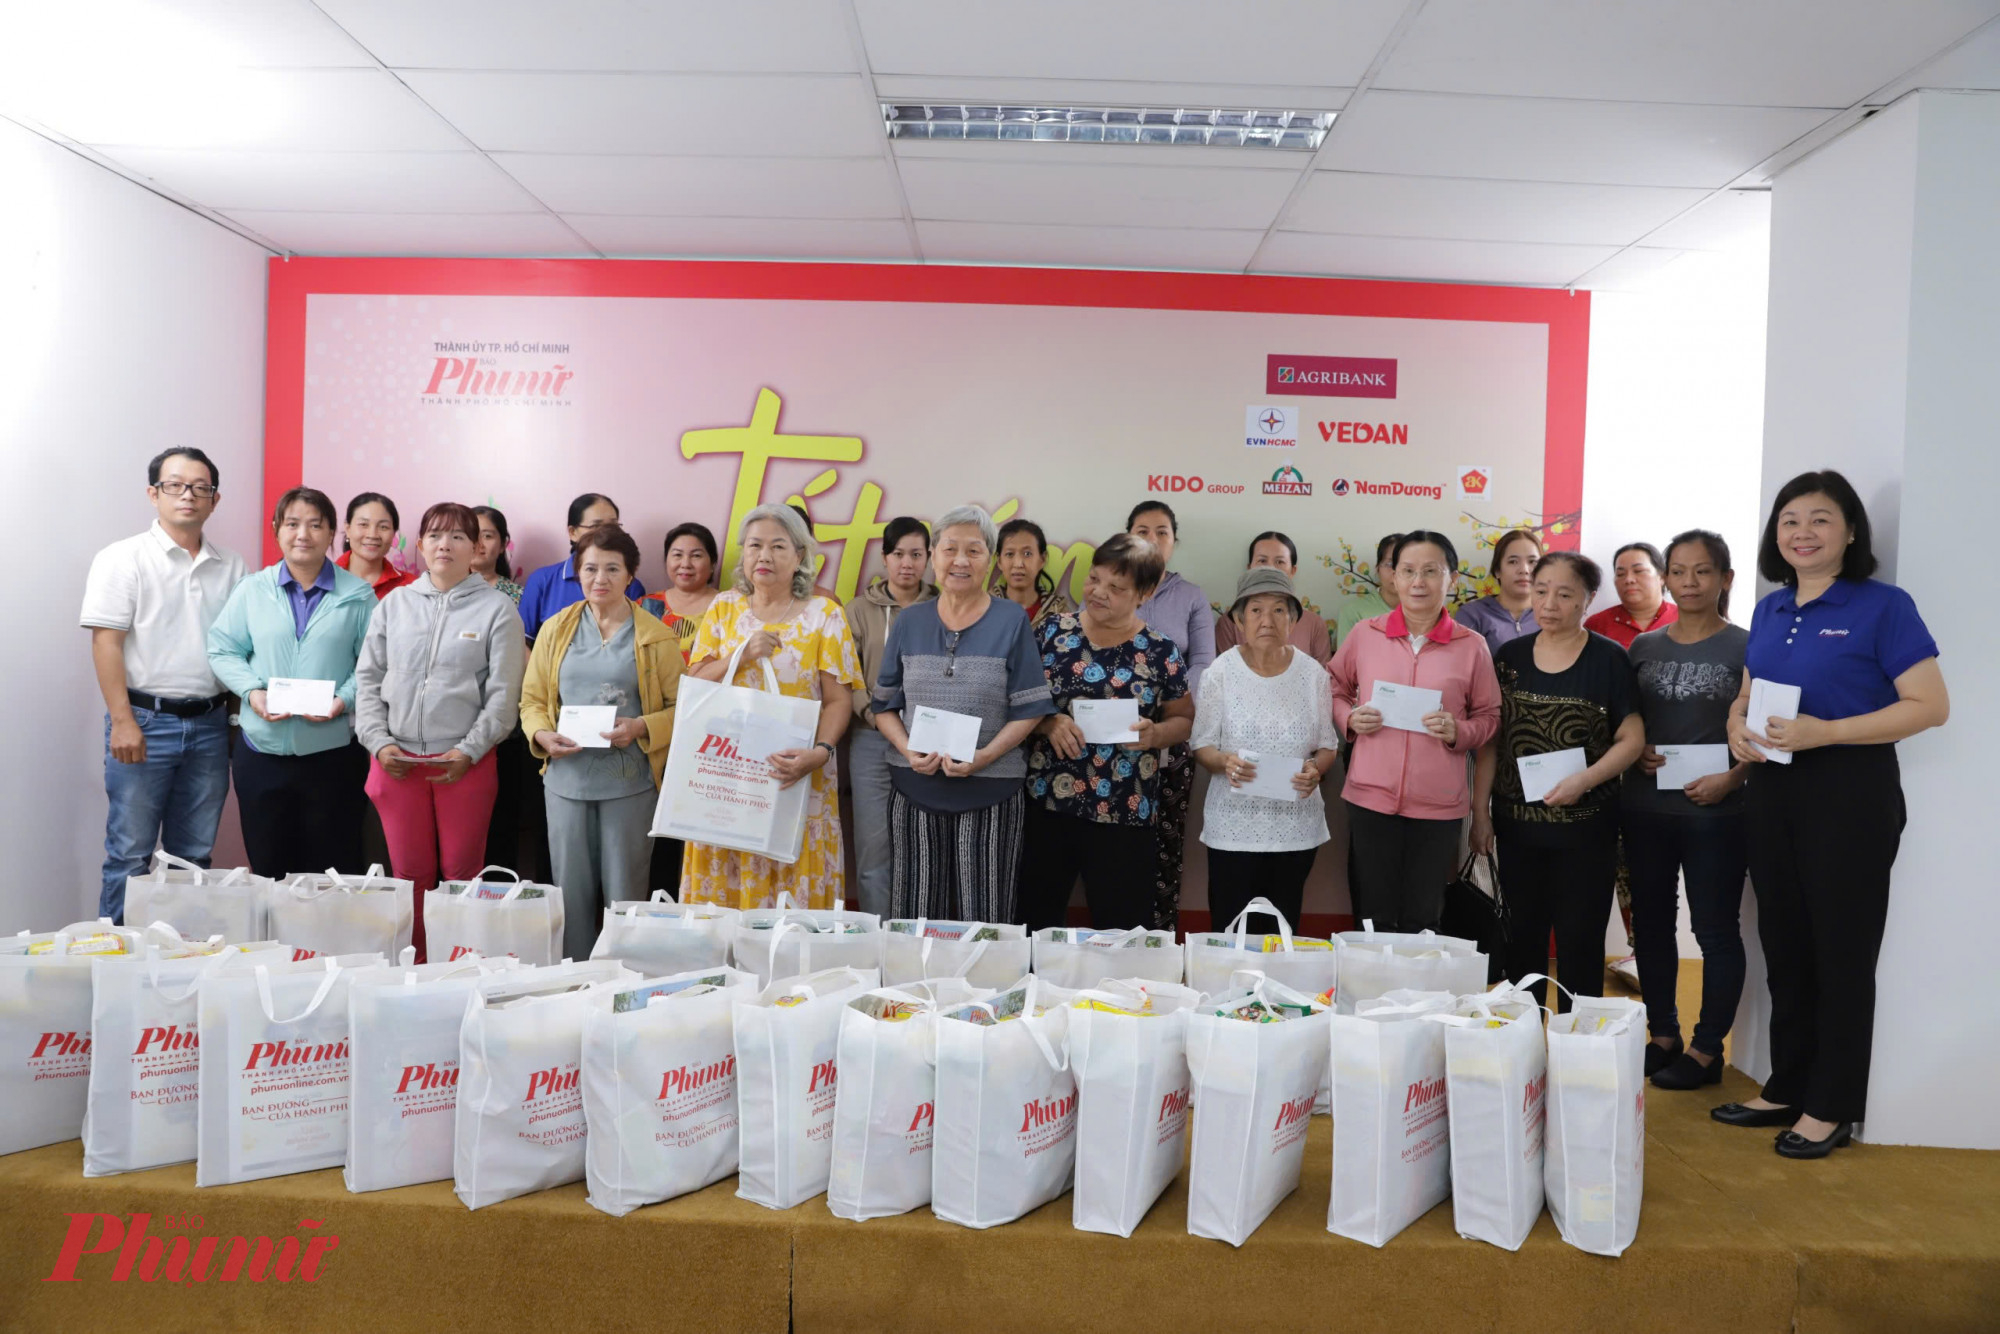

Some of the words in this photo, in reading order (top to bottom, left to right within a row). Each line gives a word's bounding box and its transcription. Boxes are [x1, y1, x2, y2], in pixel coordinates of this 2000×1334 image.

[434, 341, 470, 352] THÀNH
[473, 340, 487, 353] ỦY
[488, 343, 501, 353] TP.
[505, 341, 520, 353] HỒ
[522, 343, 539, 353] CHÍ
[541, 344, 570, 354] MINH
[1297, 371, 1386, 386] AGRIBANK
[1318, 421, 1408, 445] VEDAN
[1147, 475, 1204, 492] KIDO
[1207, 484, 1244, 494] GROUP
[1264, 483, 1311, 494] MEIZAN
[698, 767, 769, 785] phunuonline.com.vn
